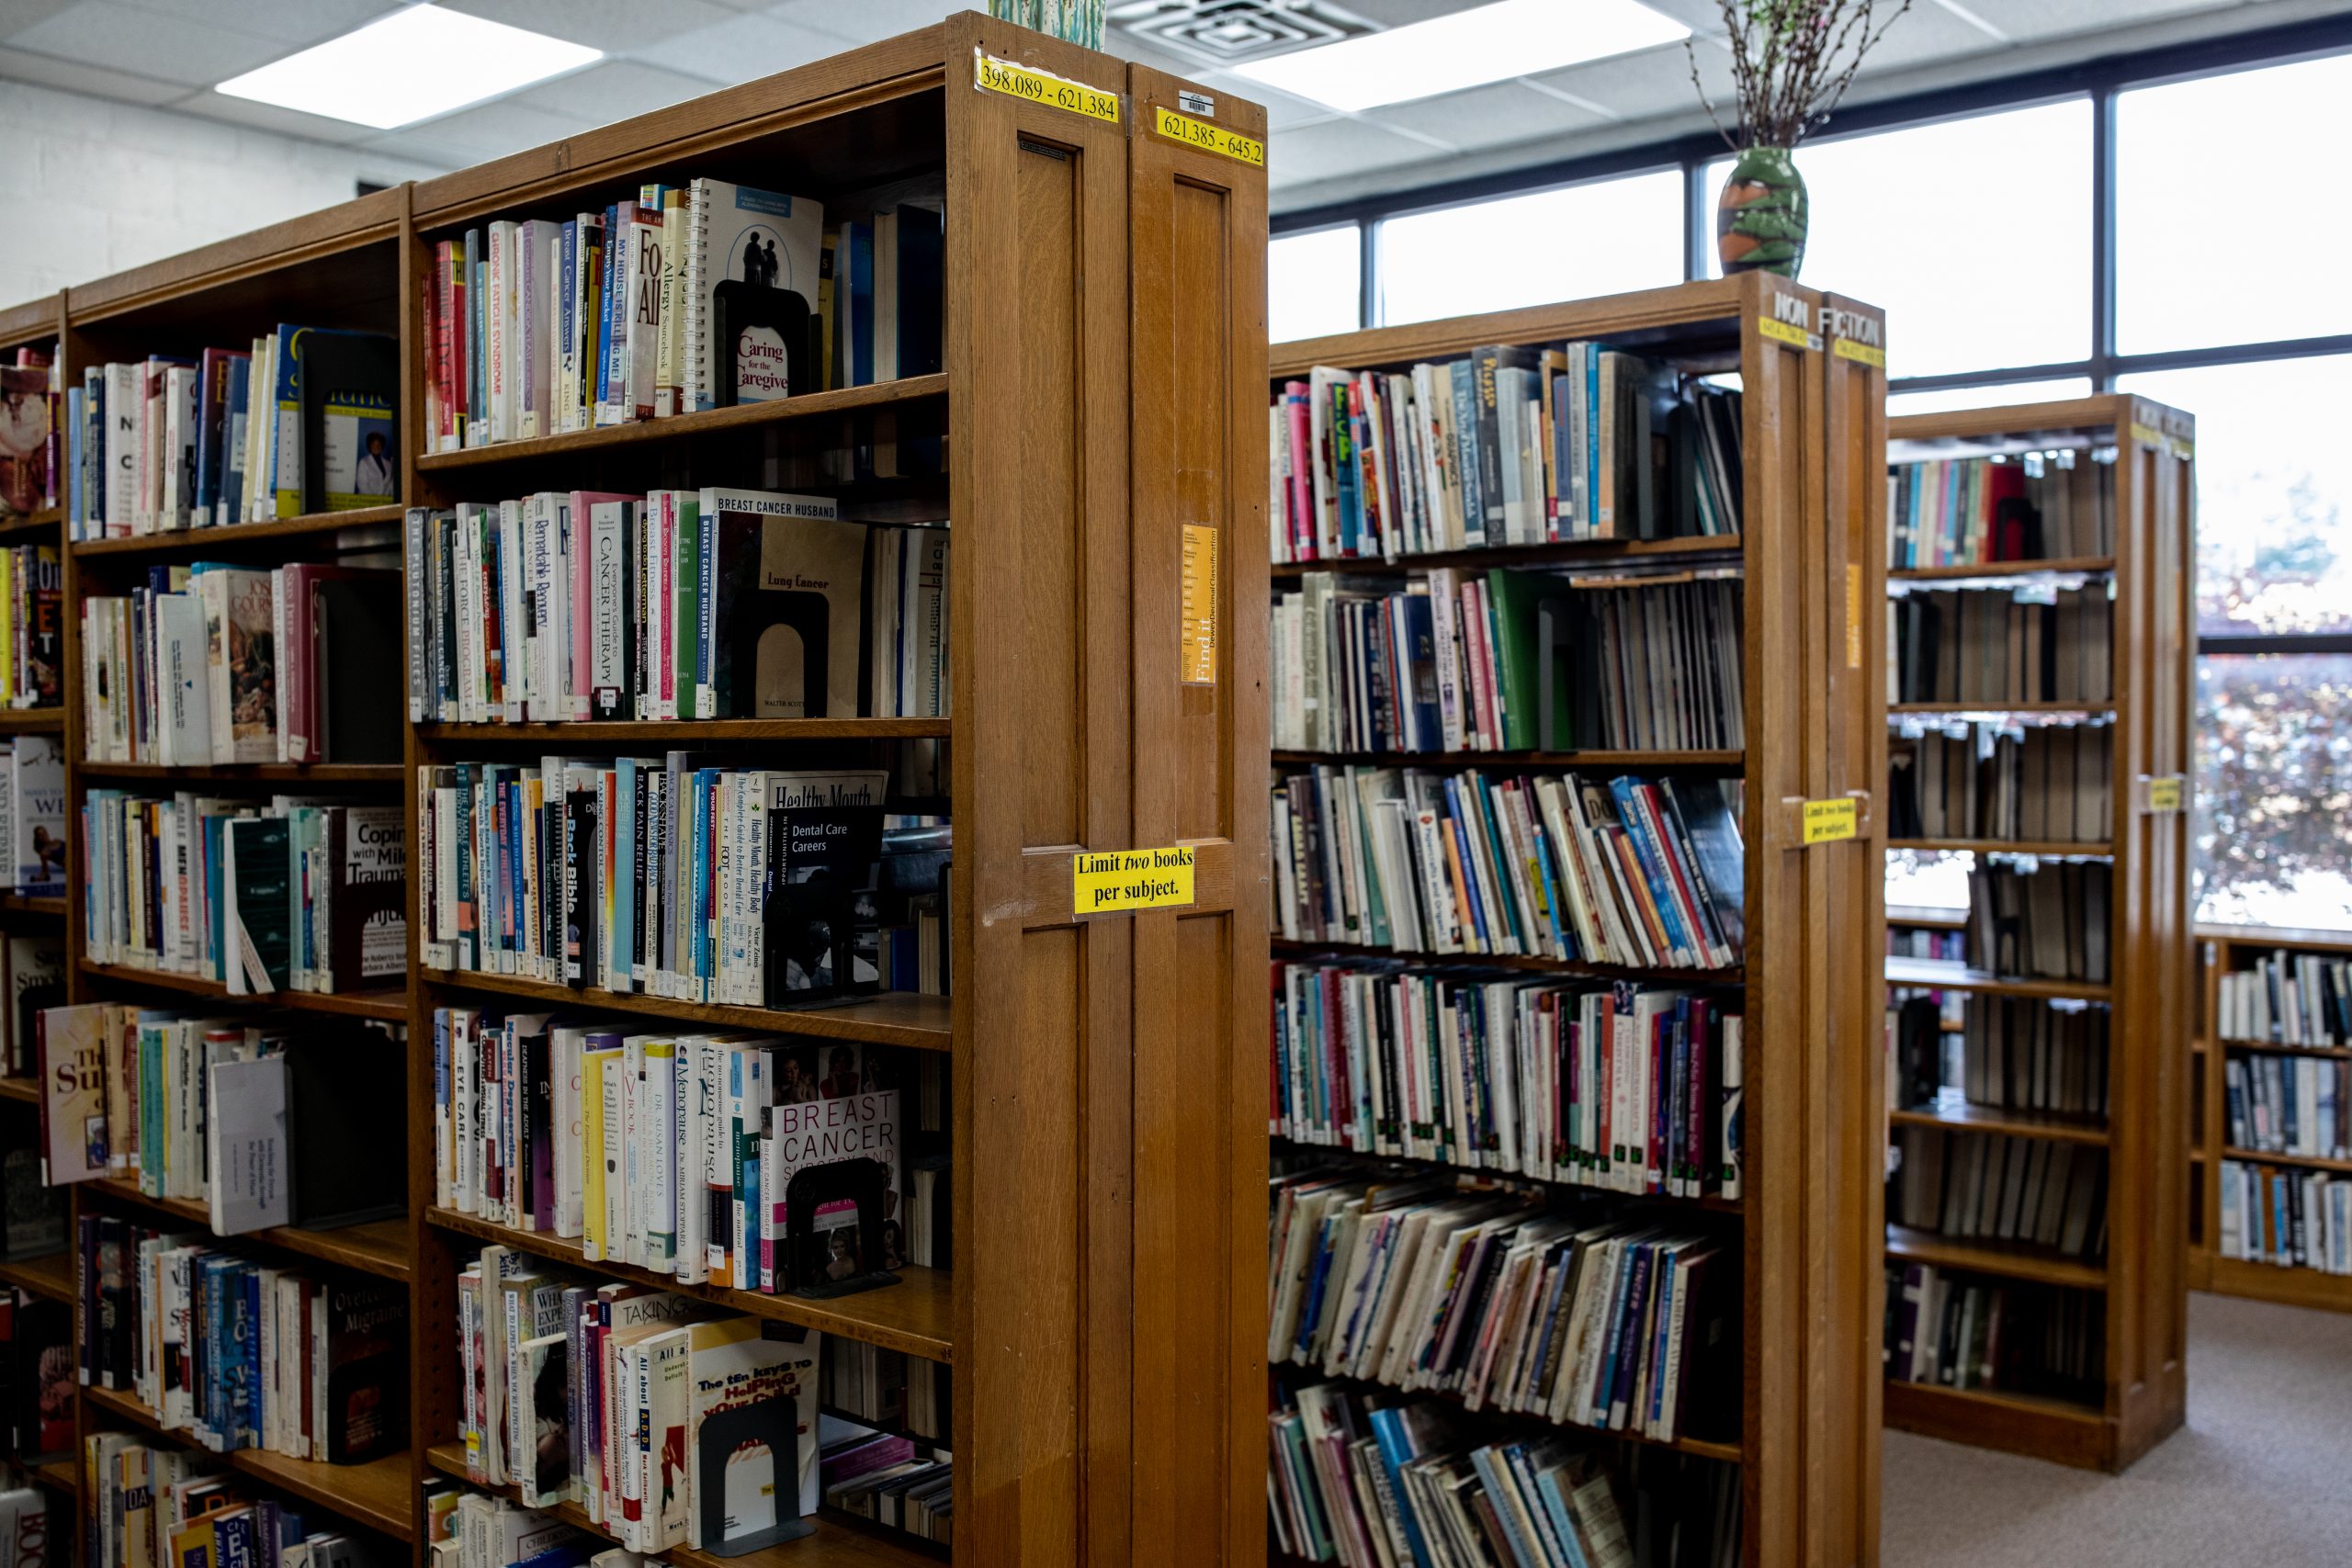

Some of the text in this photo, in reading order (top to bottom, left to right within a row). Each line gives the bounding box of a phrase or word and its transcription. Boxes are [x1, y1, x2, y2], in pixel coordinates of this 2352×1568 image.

[982, 65, 1043, 99] 398.089
[1057, 87, 1115, 119] 621.384
[1164, 115, 1216, 147] 621.385
[1227, 137, 1262, 164] 645.2
[492, 232, 500, 280] CHRONIC
[564, 229, 572, 260] Breast
[662, 262, 673, 312] Allergy
[611, 239, 626, 378] MY HOUSE IS KILLING ME!
[1773, 291, 1808, 329] NON
[1817, 307, 1880, 346] FICTION
[563, 308, 571, 352] Answers
[661, 315, 669, 368] Sourcebook
[738, 335, 783, 363] Caring
[492, 331, 501, 395] SYNDROME
[748, 360, 771, 370] for the
[718, 498, 834, 518] BREAST CANCER HUSBAND
[535, 520, 550, 627] Remarkable Recovery
[649, 508, 659, 600] Breast Fitness
[768, 572, 829, 588] Lung Cancer
[412, 519, 421, 685] THE PLUTONIUM FILES
[601, 536, 612, 682] CANCER THERAPY
[612, 647, 618, 657] to
[1196, 618, 1211, 682] Find it
[659, 777, 667, 808] BACK
[738, 777, 746, 790] The
[776, 784, 870, 807] Healthy Mouth
[636, 811, 644, 840] PAIN
[737, 791, 745, 822] Complete
[566, 818, 576, 863] Back
[736, 825, 745, 844] Guide
[792, 841, 827, 852] Careers
[793, 824, 847, 837] Dental Care
[353, 847, 375, 859] with
[636, 844, 644, 882] RELIEF
[721, 845, 729, 870] FOOT
[736, 854, 744, 875] Better
[748, 819, 762, 914] Healthy Mouth, Healthy Body
[1078, 849, 1193, 874] Limit two books
[462, 848, 470, 898] ATHLETE'S
[567, 867, 577, 913] Bible
[735, 878, 744, 899] Dental
[1094, 879, 1179, 907] per subject.
[457, 1066, 466, 1143] EYE CARE
[506, 1021, 515, 1168] Macular Degeneration
[676, 1067, 688, 1145] Menopause
[707, 1048, 715, 1179] menopause
[784, 1093, 893, 1134] BREAST
[784, 1122, 893, 1162] CANCER
[660, 1348, 673, 1361] All
[664, 1371, 683, 1382] Deficit
[698, 1381, 723, 1391] The
